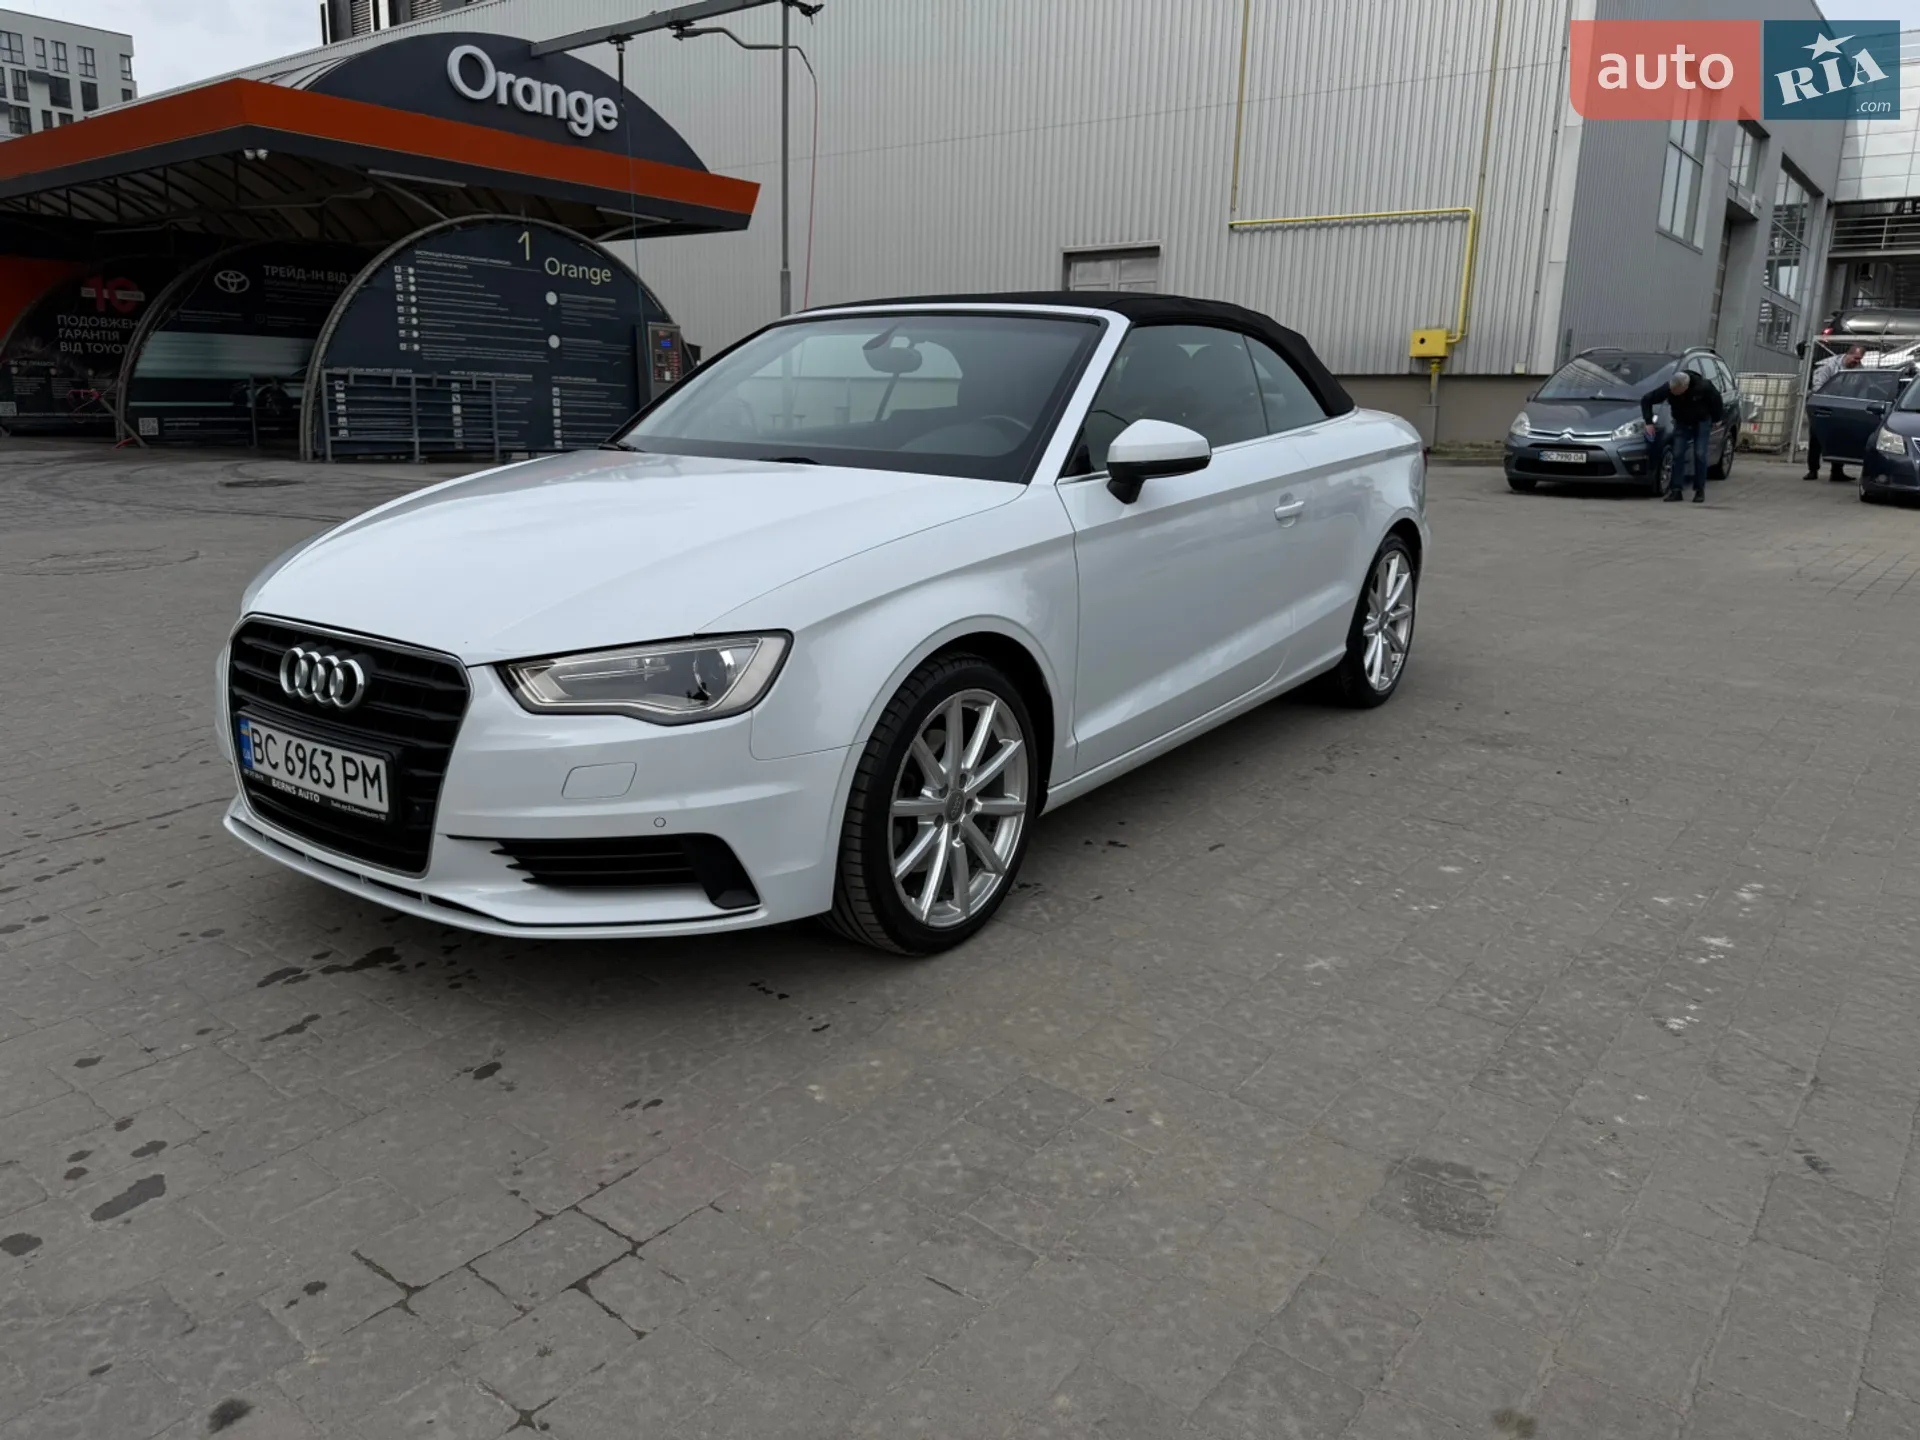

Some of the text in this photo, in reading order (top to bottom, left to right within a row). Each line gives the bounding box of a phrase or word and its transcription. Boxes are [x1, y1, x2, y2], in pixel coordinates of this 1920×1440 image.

[447, 44, 619, 137] Orange
[517, 231, 531, 262] 1
[327, 271, 349, 285] ВІД
[544, 257, 612, 285] Orange
[86, 275, 140, 314] 10
[58, 328, 120, 342] ГАРАНТІЯ
[60, 341, 84, 354] ВІД
[251, 727, 383, 803] BC 6963 PM
[271, 779, 321, 804] BERNS AUTO
